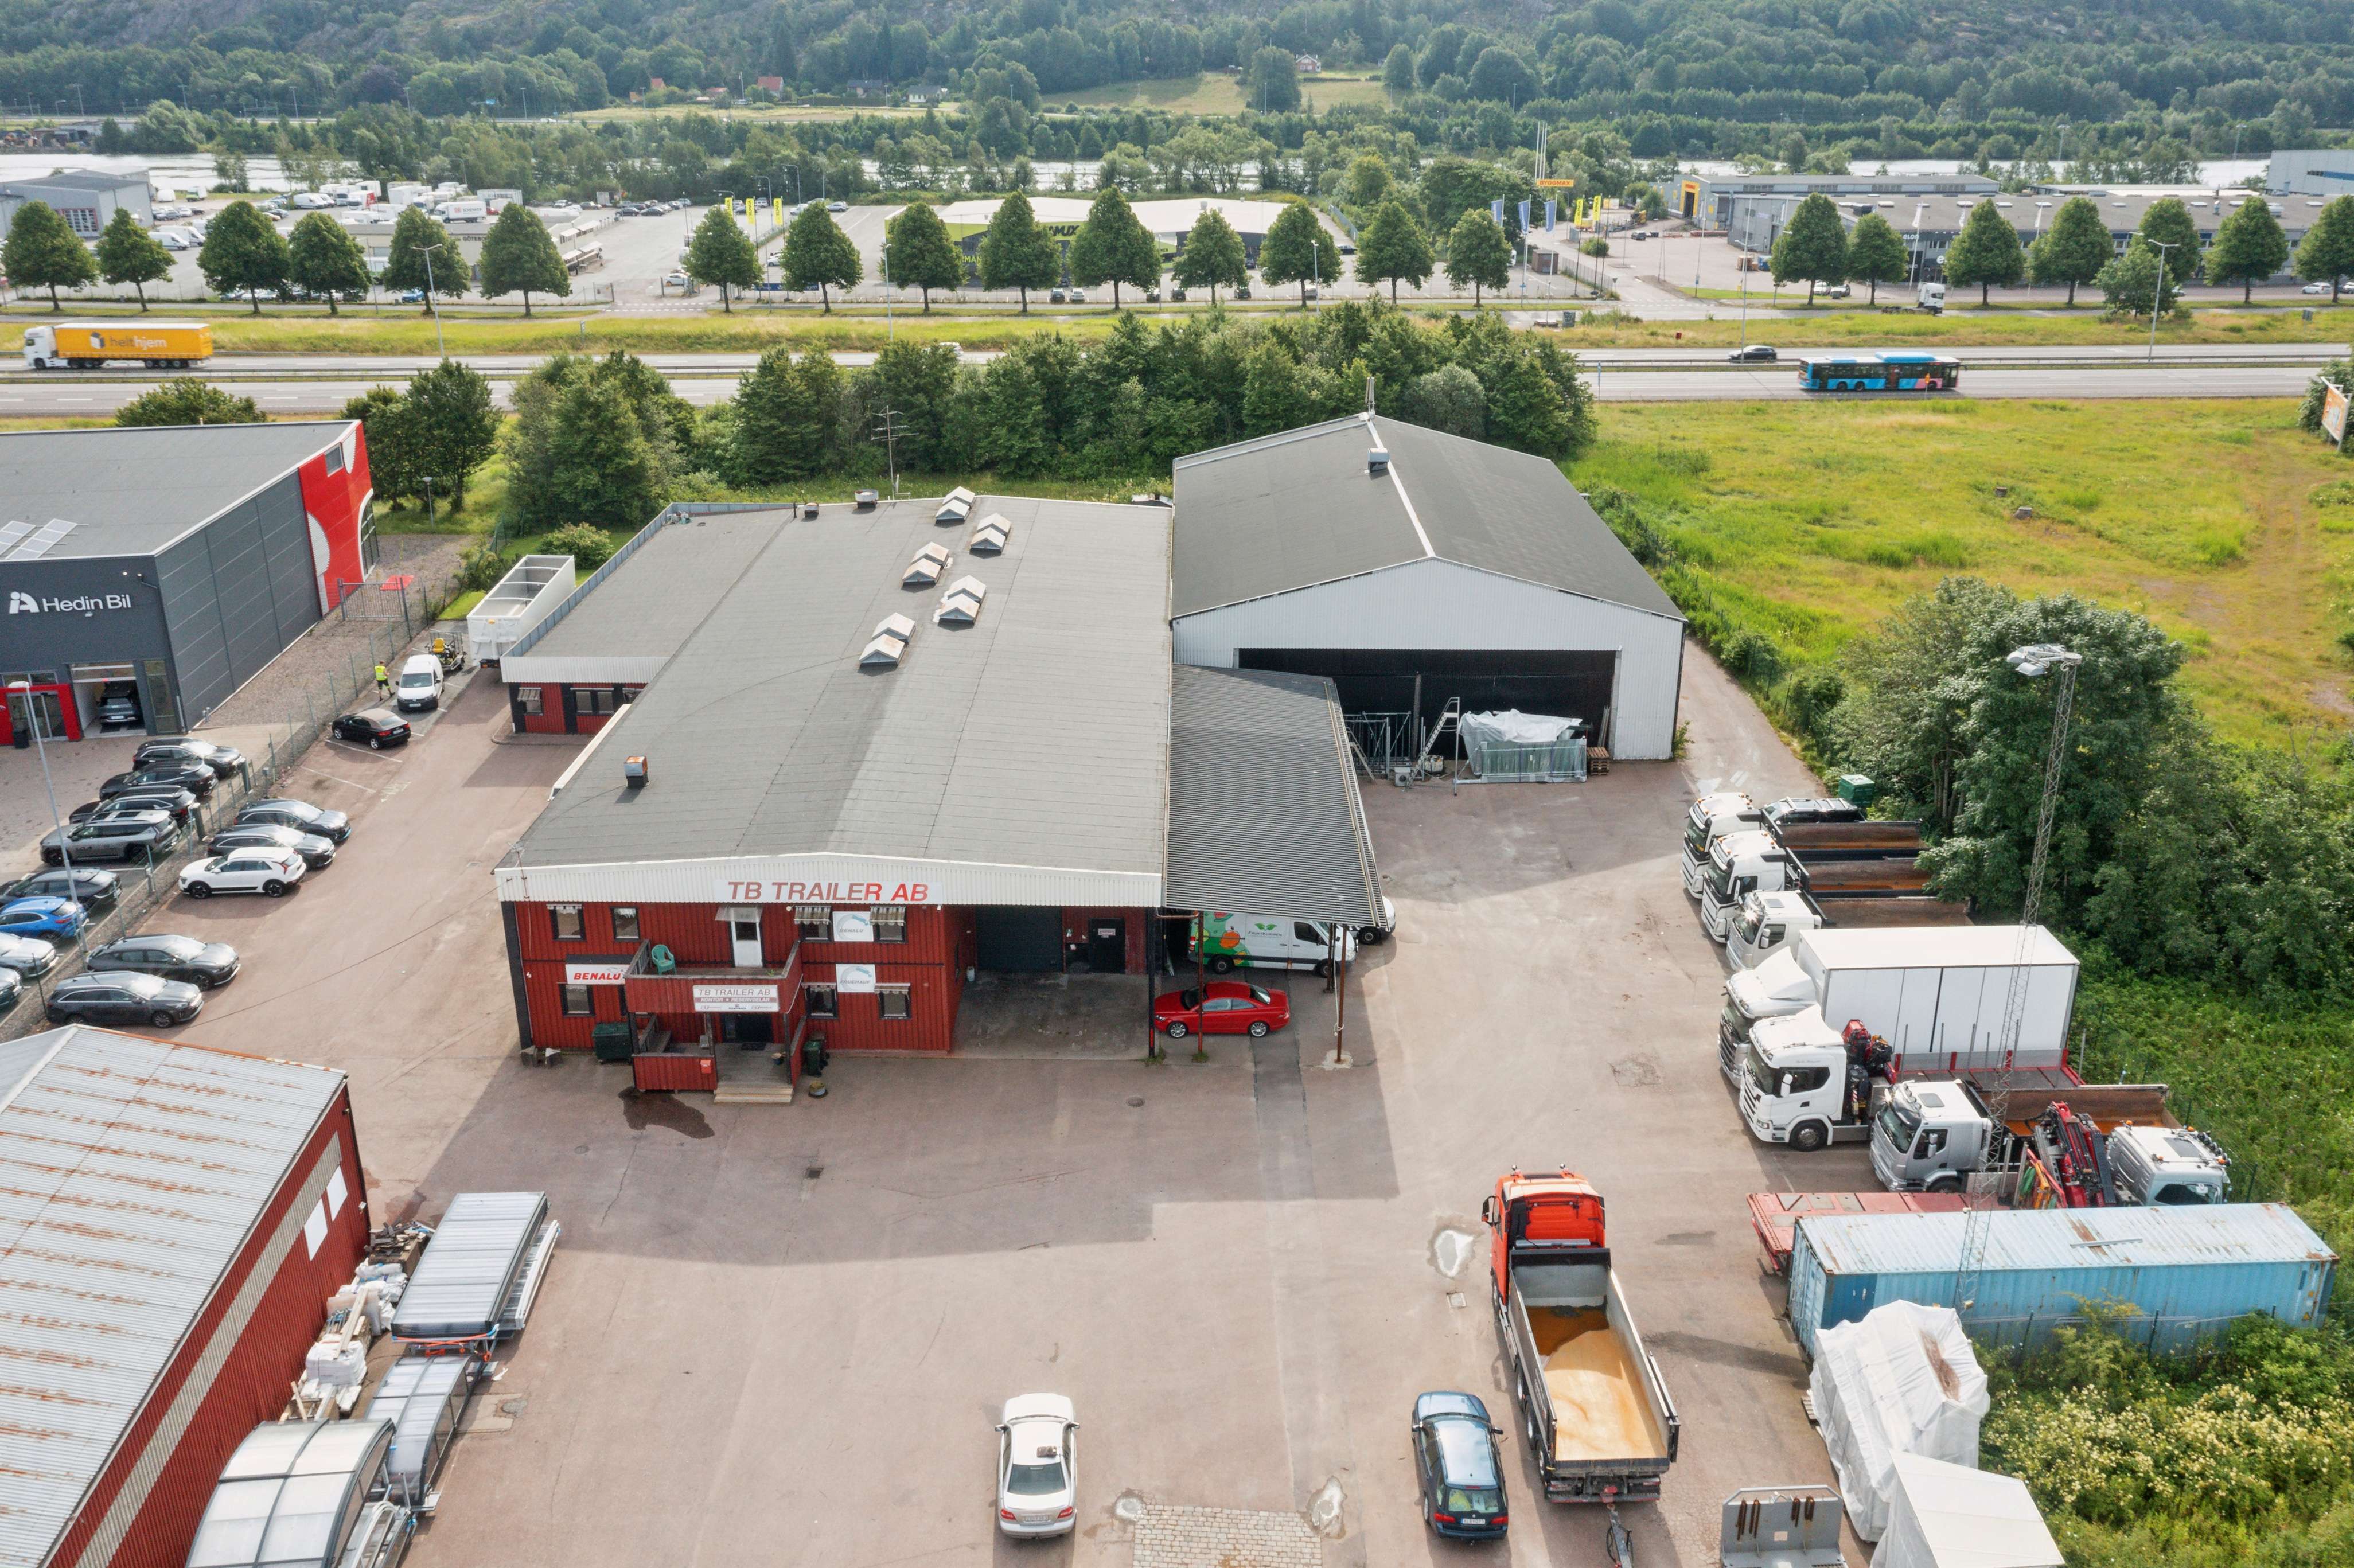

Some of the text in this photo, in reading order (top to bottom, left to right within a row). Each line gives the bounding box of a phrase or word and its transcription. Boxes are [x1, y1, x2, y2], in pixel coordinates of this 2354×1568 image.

[42, 594, 131, 612] Hedin Bil
[728, 881, 929, 902] TB TRAILER AB
